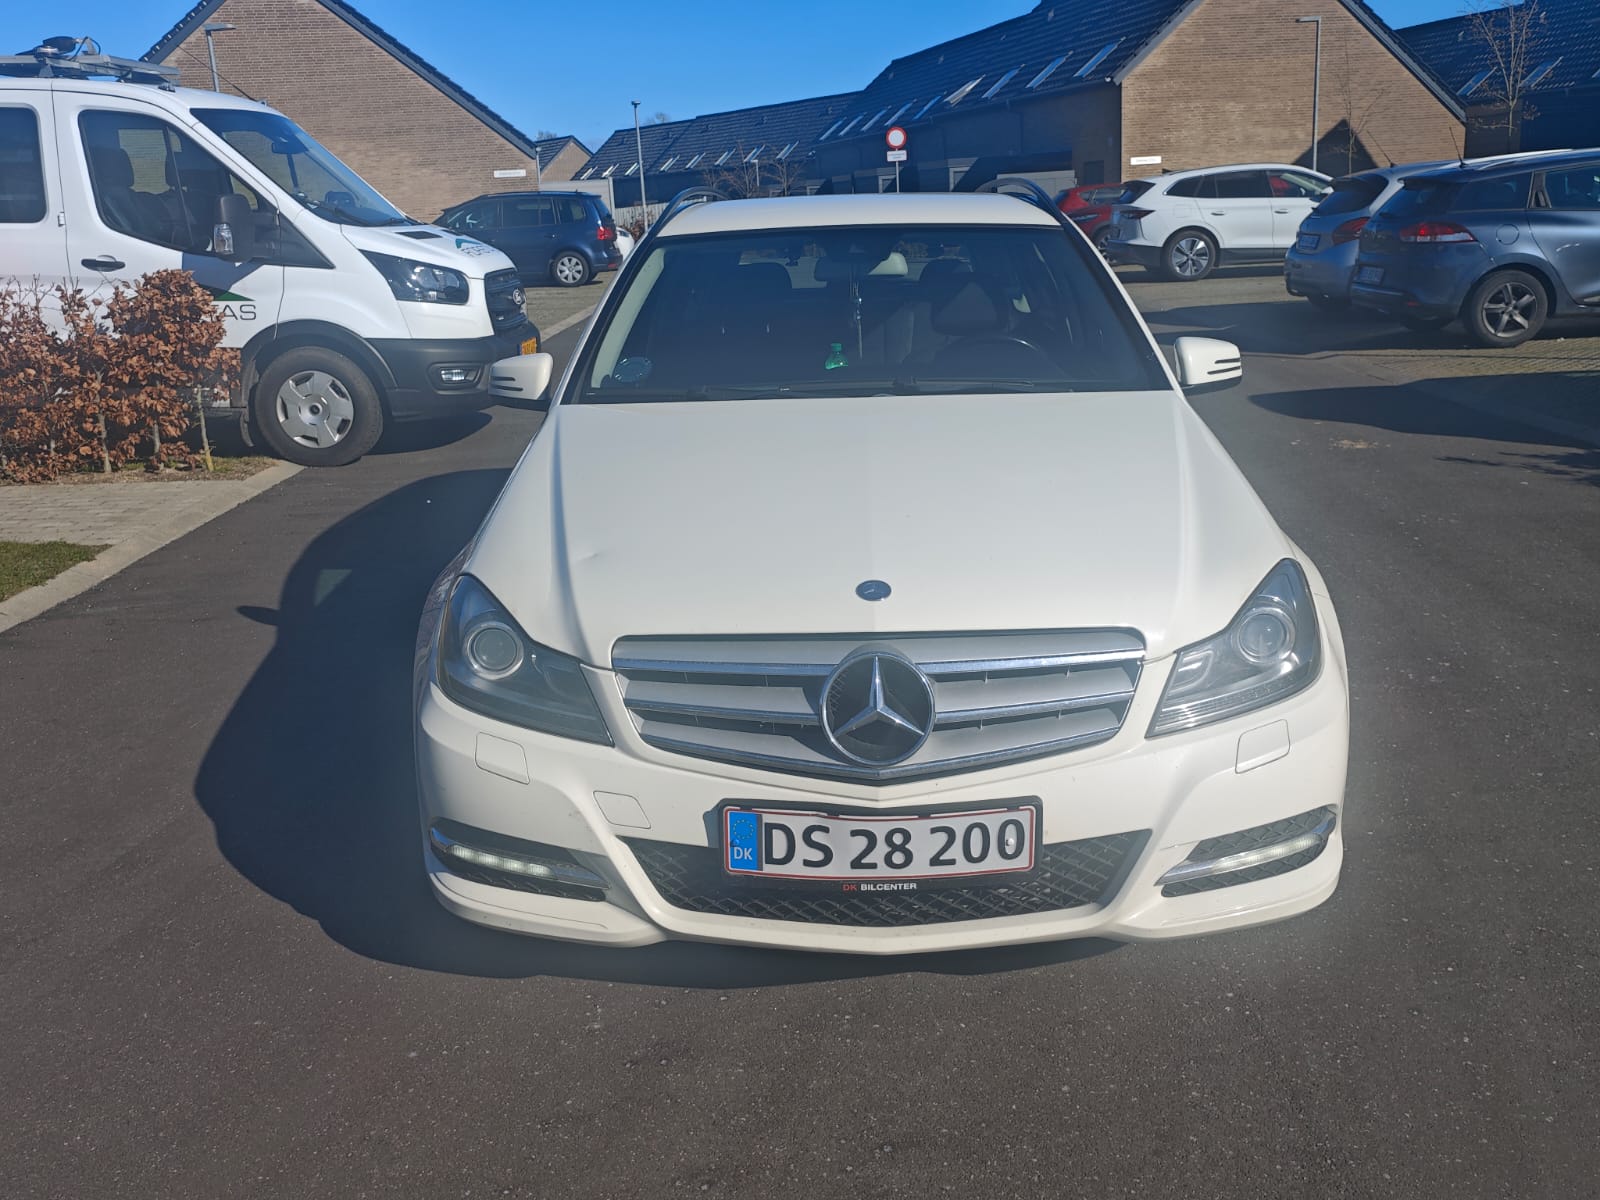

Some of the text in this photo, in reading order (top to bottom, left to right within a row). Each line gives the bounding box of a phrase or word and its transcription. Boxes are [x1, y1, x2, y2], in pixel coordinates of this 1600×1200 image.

[764, 819, 1025, 870] DS 28 200
[734, 846, 753, 860] DK
[860, 883, 917, 891] BILCENTER
